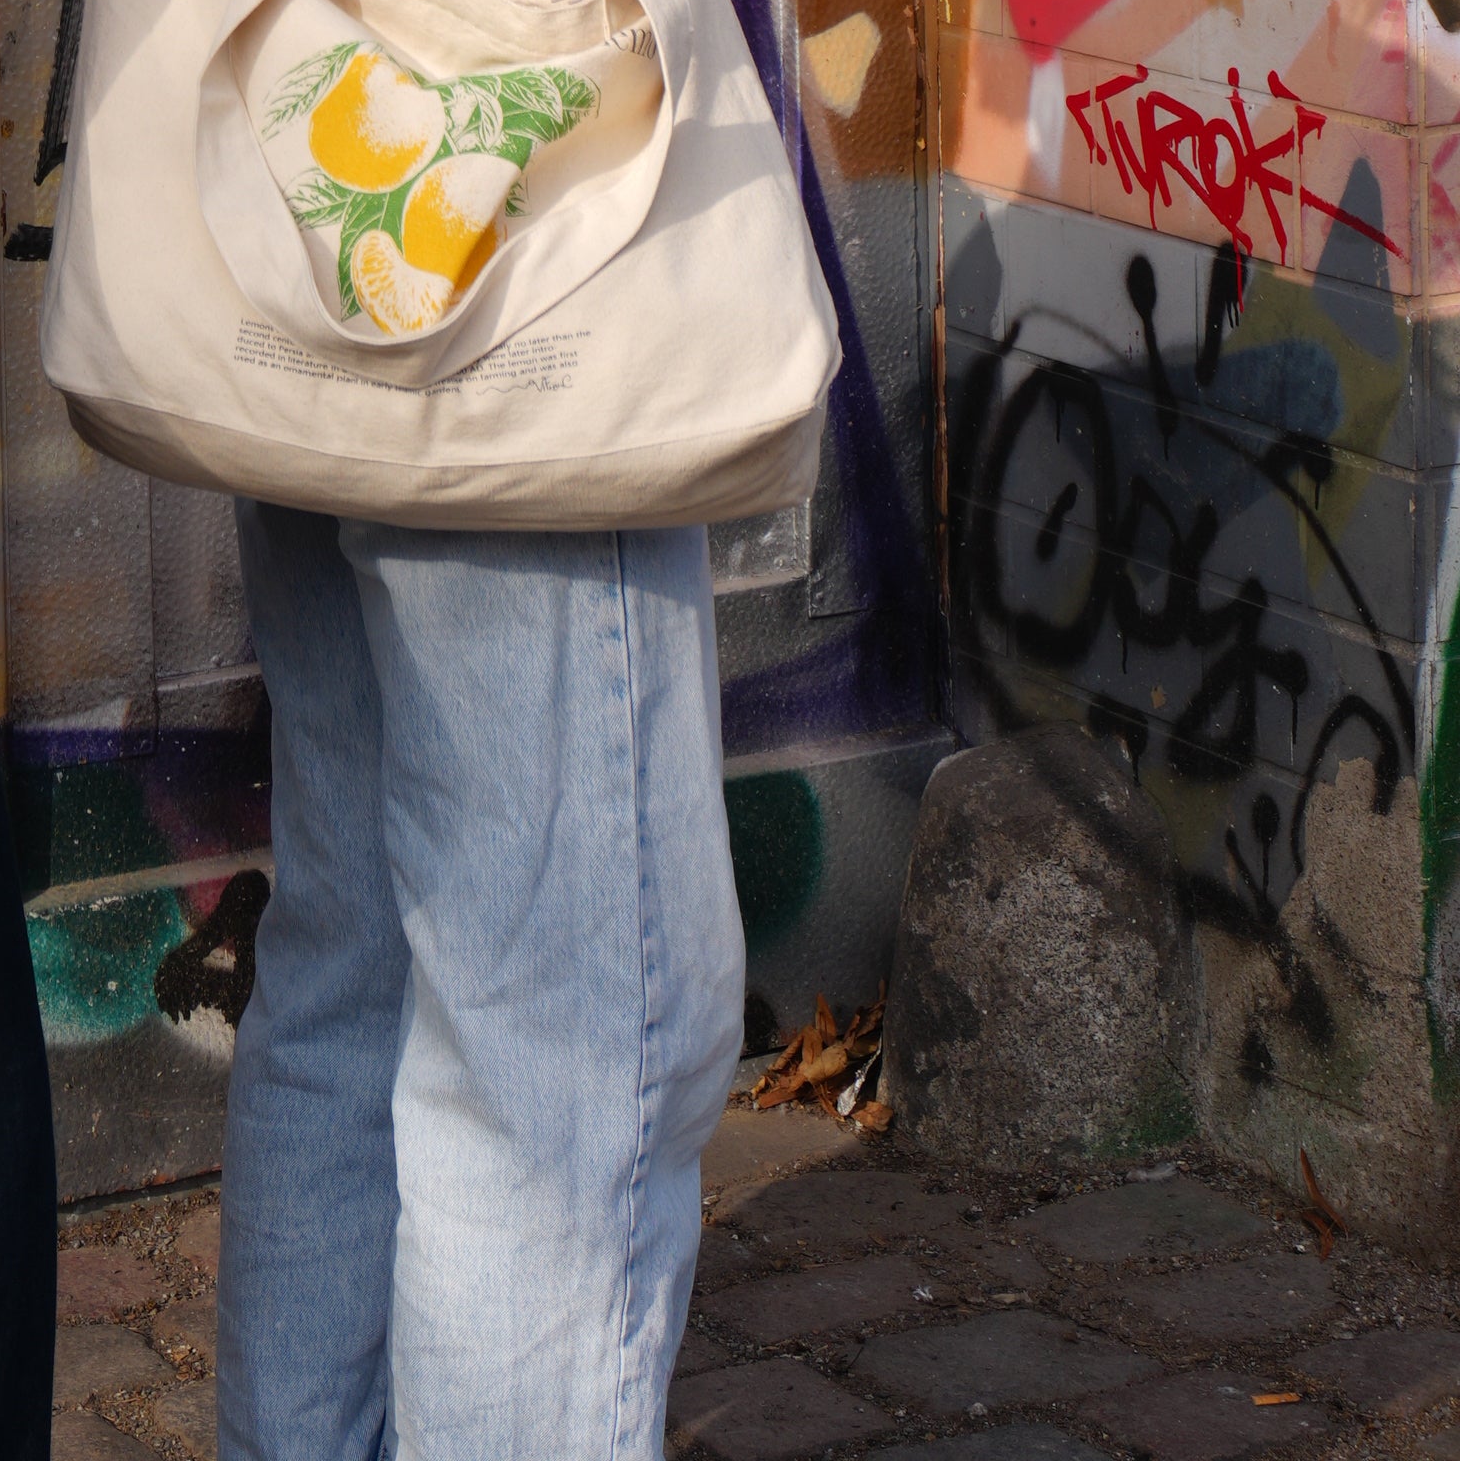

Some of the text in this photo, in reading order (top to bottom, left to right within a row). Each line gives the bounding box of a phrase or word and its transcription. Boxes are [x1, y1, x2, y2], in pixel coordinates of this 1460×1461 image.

[528, 336, 549, 346] later
[552, 333, 574, 343] than
[576, 330, 591, 339] the
[540, 354, 557, 363] was
[559, 350, 579, 360] first
[519, 366, 537, 377] and
